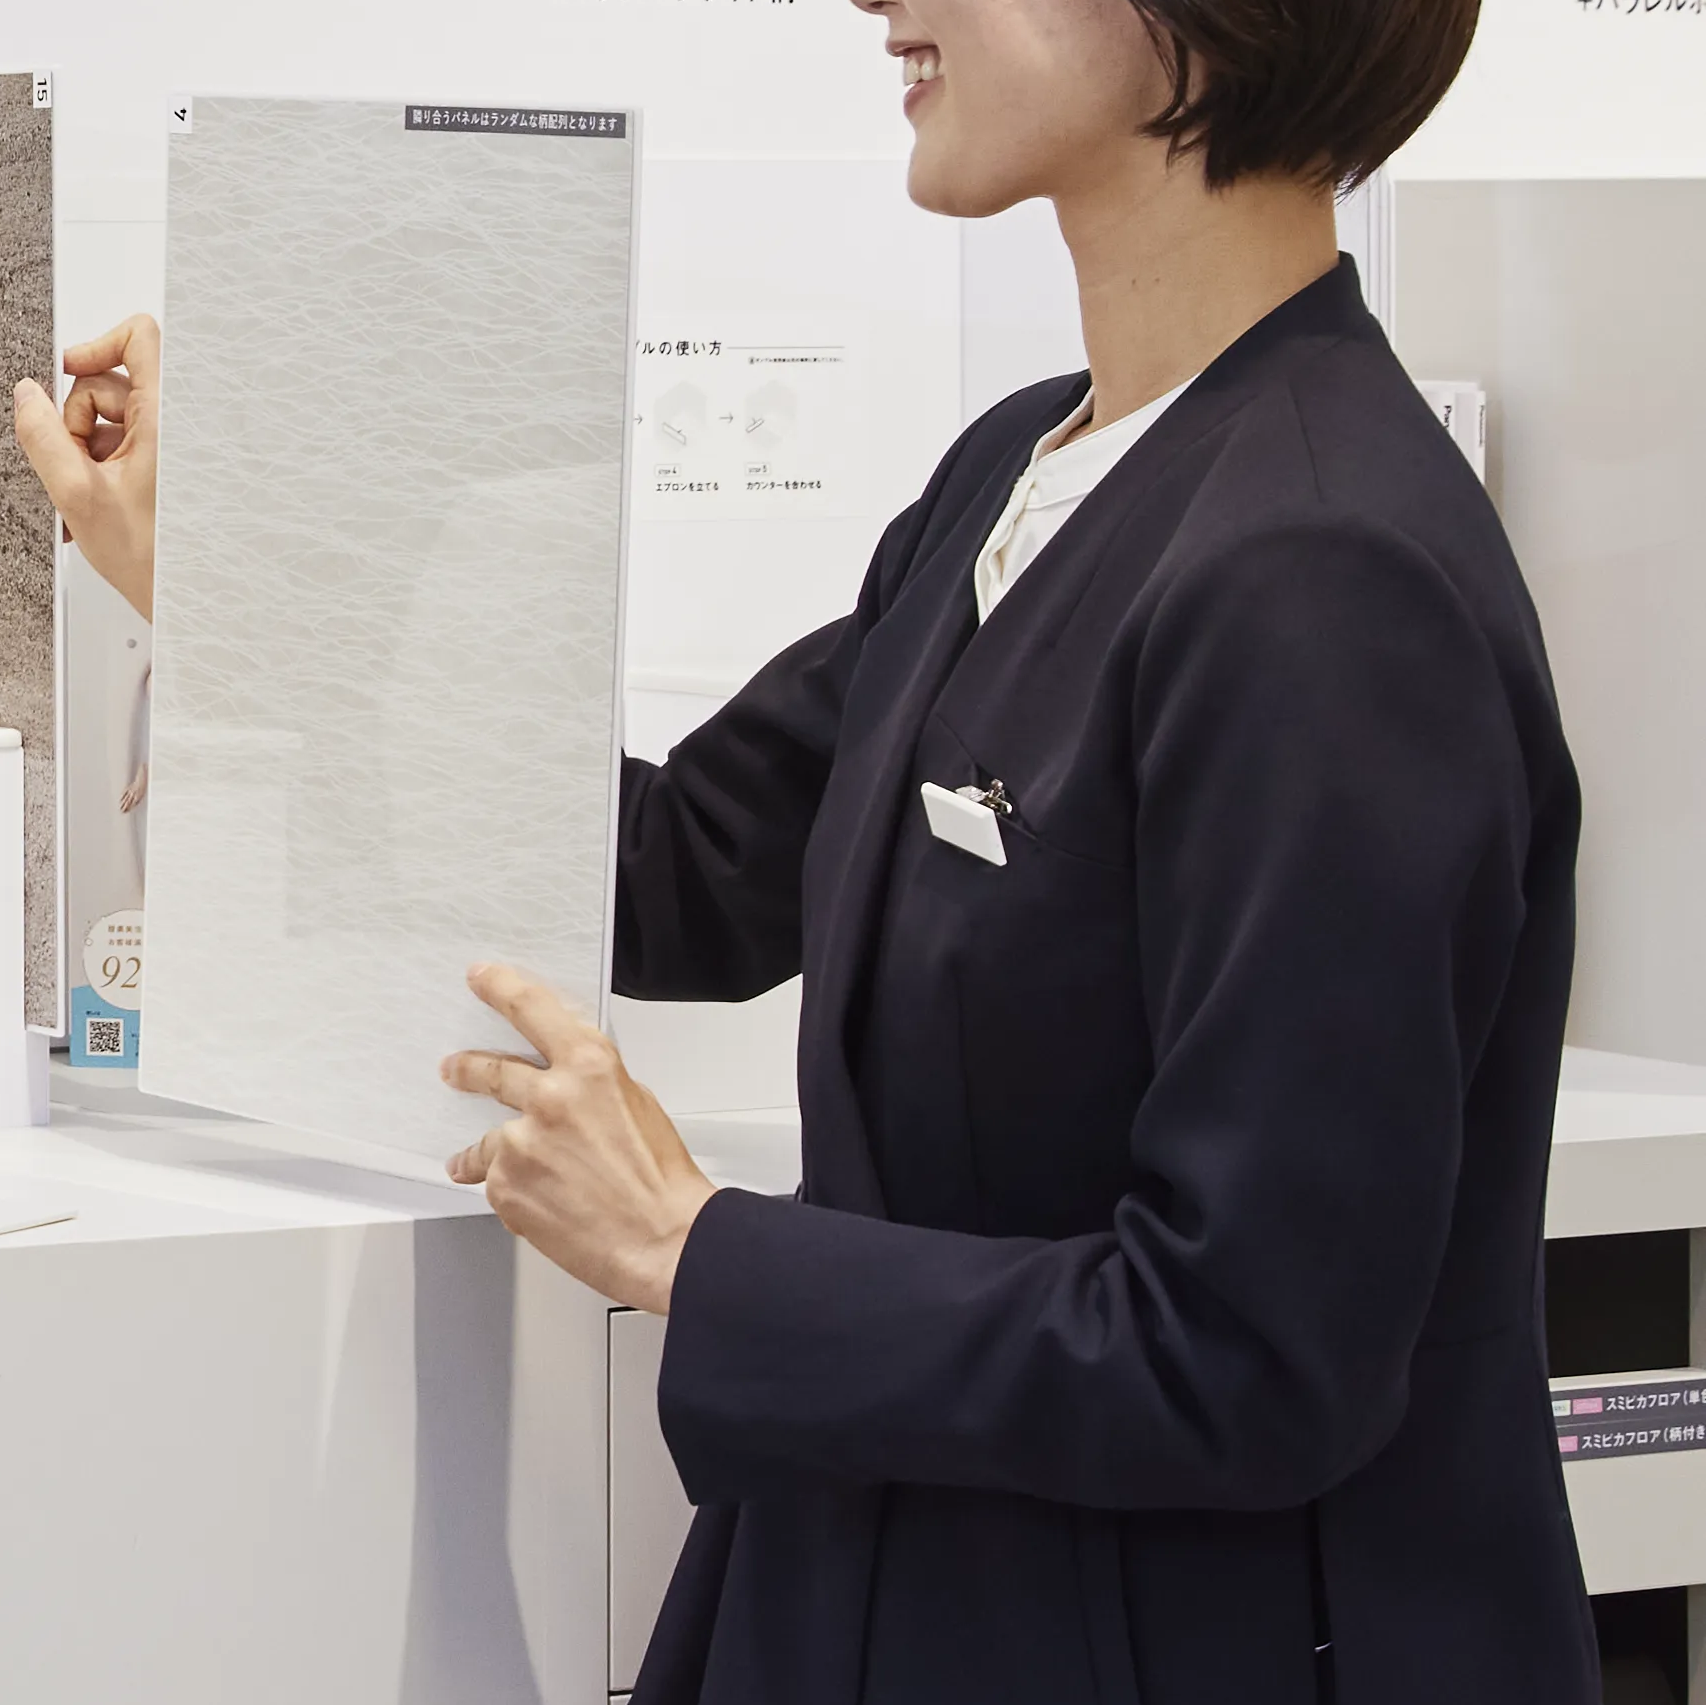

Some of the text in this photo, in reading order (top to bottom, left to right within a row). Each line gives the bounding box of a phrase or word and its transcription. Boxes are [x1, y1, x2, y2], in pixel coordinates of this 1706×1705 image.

[37, 78, 48, 102] 15
[413, 109, 619, 132] 隣り合うパネルはランダムな柄配列となります
[635, 340, 722, 356] ルの使い方
[100, 956, 141, 988] 92
